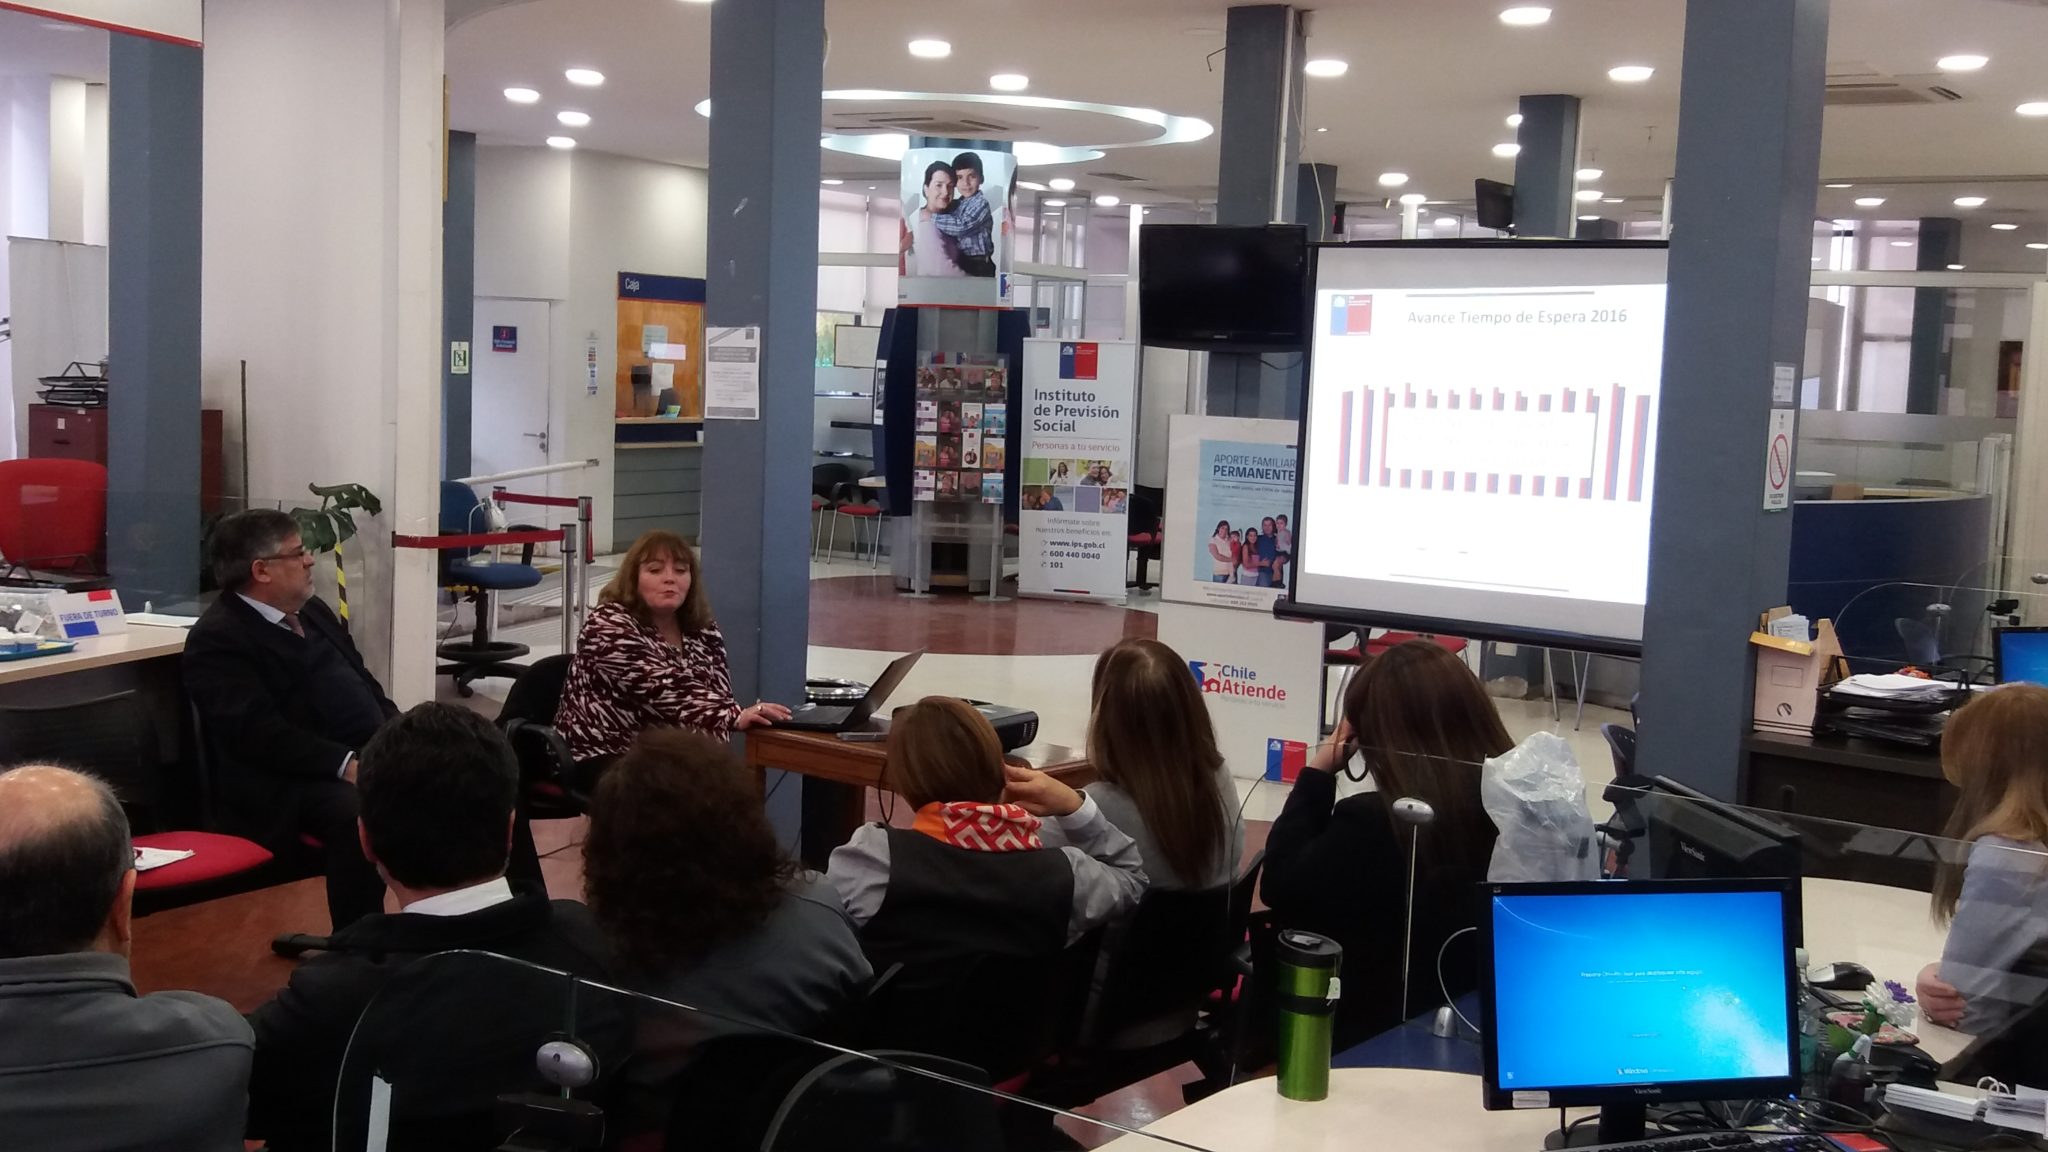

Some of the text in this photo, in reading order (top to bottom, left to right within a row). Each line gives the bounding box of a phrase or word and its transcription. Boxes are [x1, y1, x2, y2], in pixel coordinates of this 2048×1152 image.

[625, 278, 640, 293] Caja
[1407, 309, 1628, 326] Avance Tiempo de Espera 2016
[1034, 388, 1096, 402] Instituto
[1033, 404, 1119, 418] de Previsión
[1033, 419, 1076, 432] Social
[1032, 441, 1068, 450] Personas
[1077, 443, 1086, 451] tu
[1088, 444, 1120, 452] servicio
[1214, 454, 1296, 468] APORTE FAMILIAR
[1213, 465, 1295, 481] PERMANENTE
[1049, 540, 1106, 549] www.ips.gob.cl
[1065, 551, 1080, 559] 440
[1081, 552, 1101, 560] 0040
[60, 608, 118, 621] FUERA DE TURNO
[1222, 664, 1257, 680] Chile
[1222, 680, 1286, 700] Atiende
